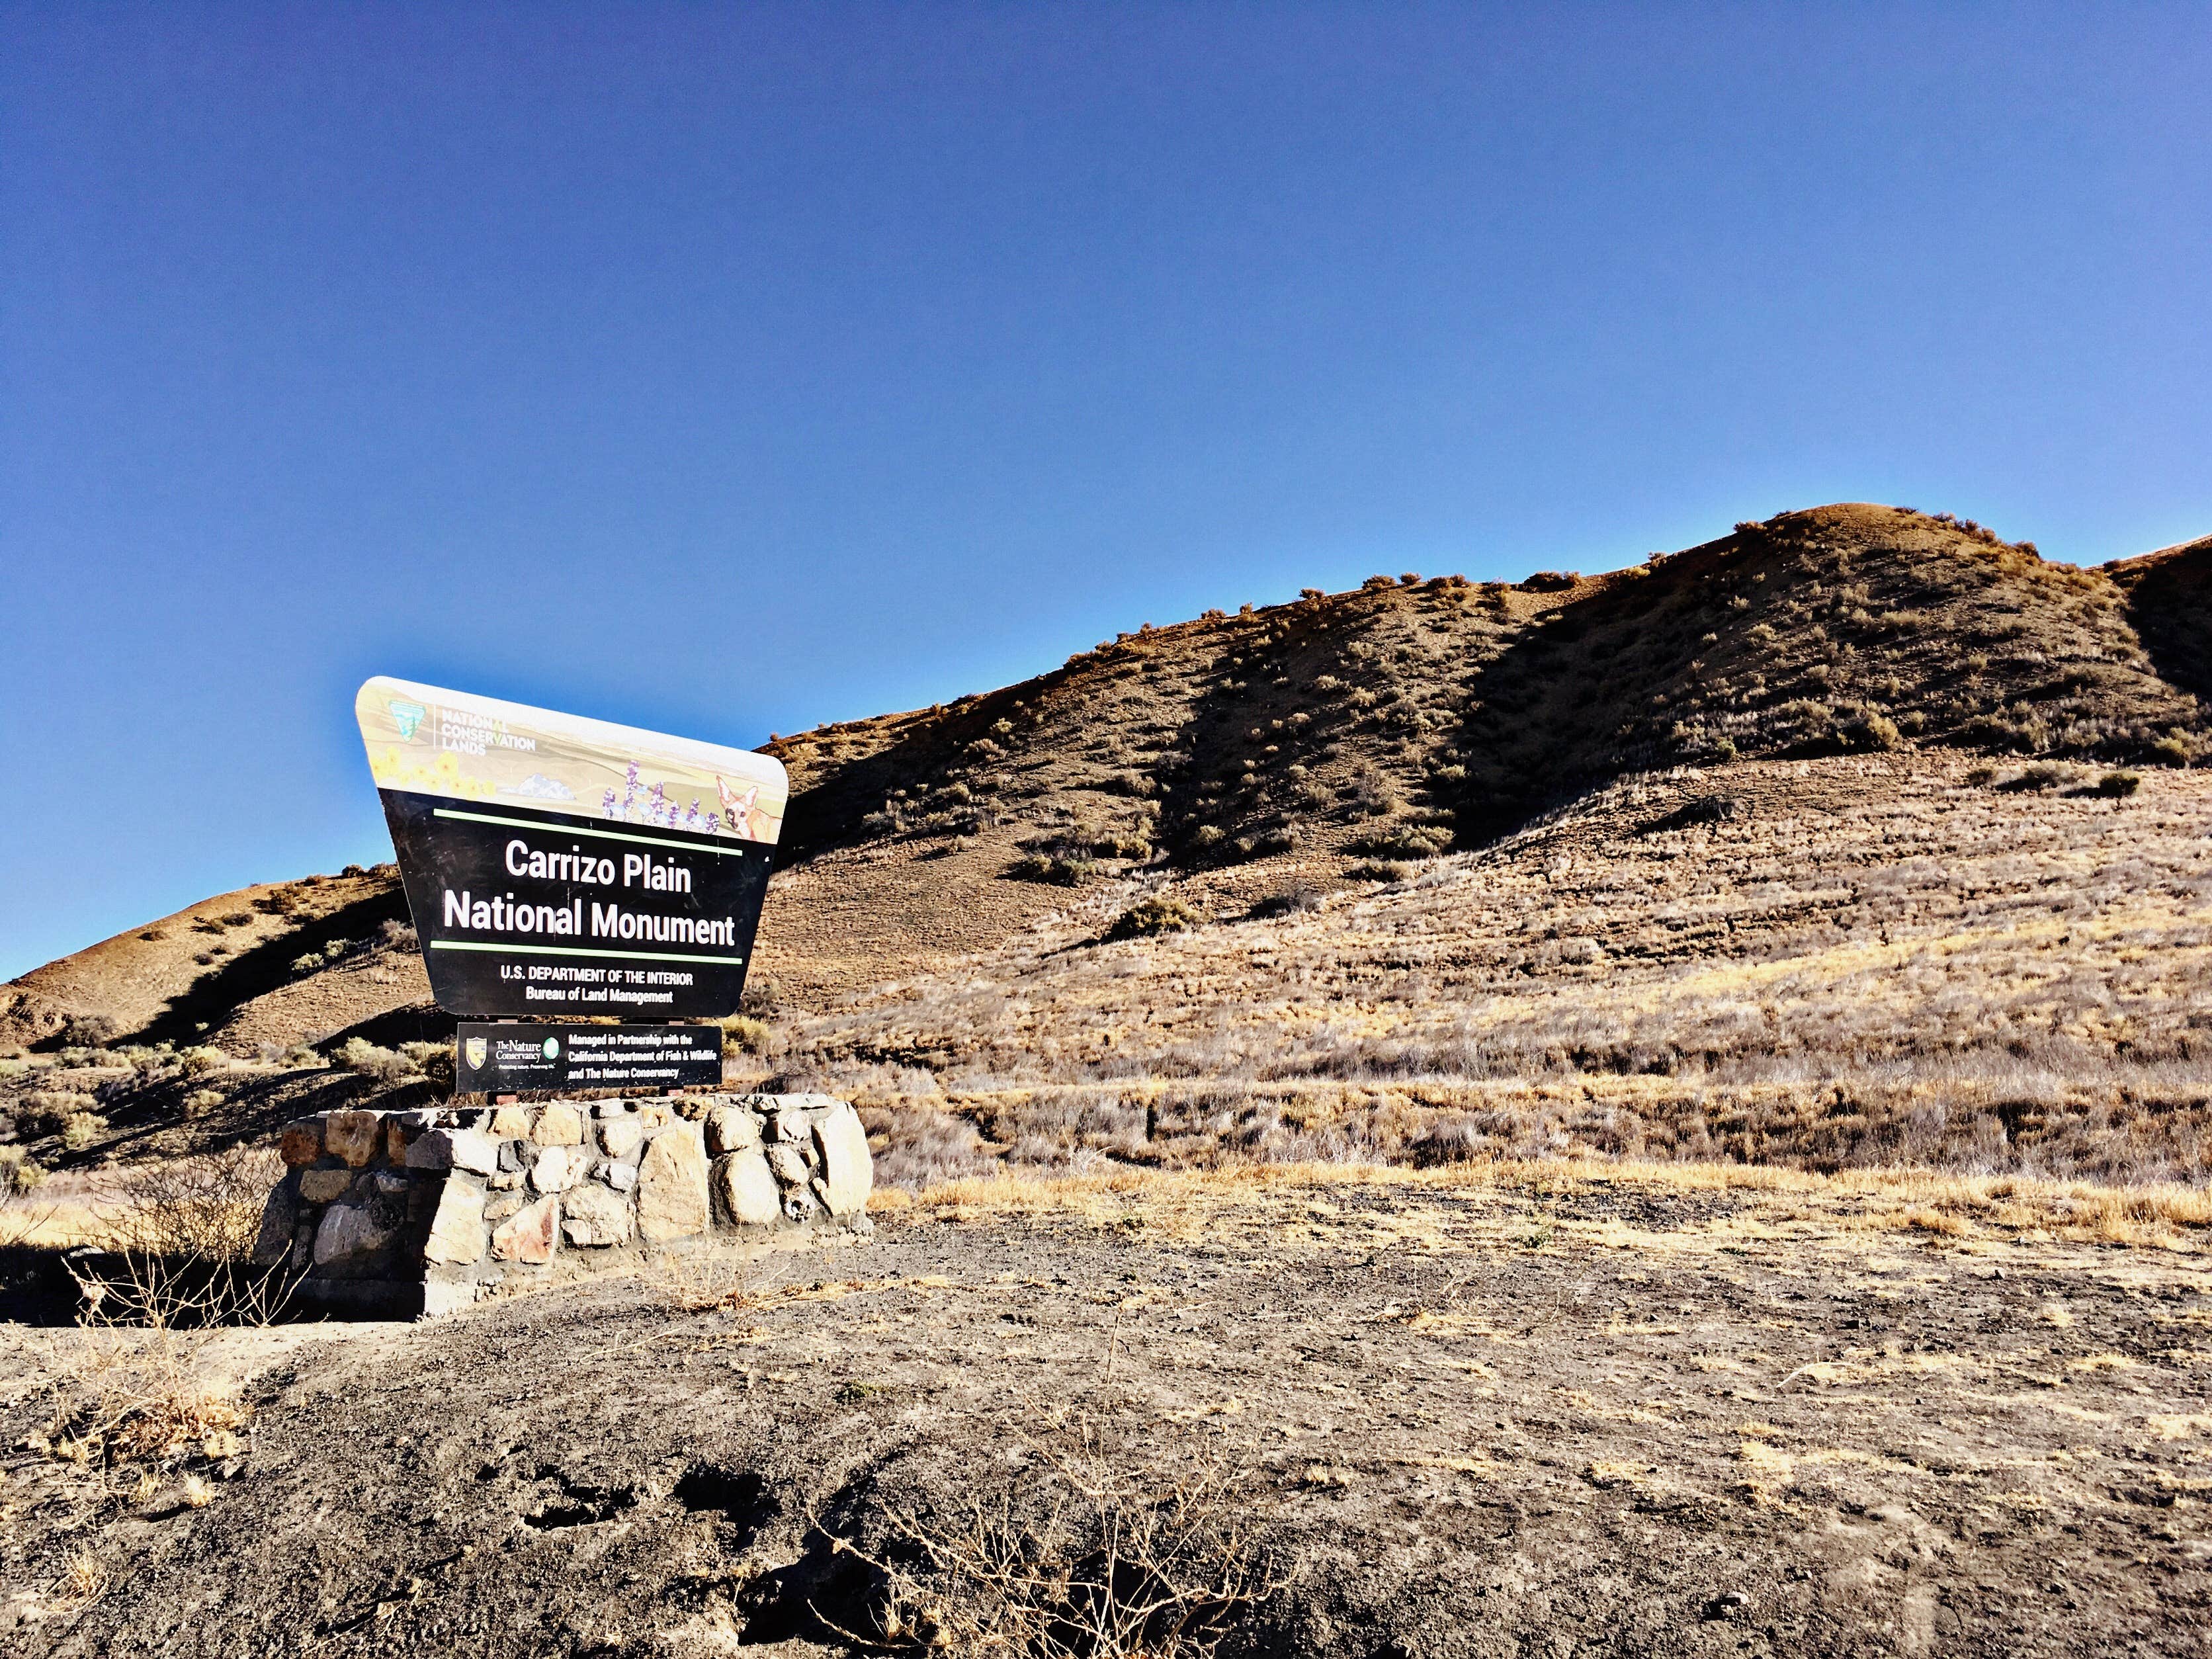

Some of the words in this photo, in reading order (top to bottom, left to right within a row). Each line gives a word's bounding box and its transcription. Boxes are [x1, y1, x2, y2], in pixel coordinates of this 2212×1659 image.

[442, 709, 509, 732] NATIONAL
[441, 723, 536, 751] CONSERVATION
[443, 738, 486, 756] LANDS
[505, 839, 615, 886] Carrizo
[624, 853, 691, 893] Plain
[444, 889, 581, 935] National
[592, 902, 735, 946] Monument
[501, 965, 525, 980] U.S.
[529, 966, 607, 982] DEPARTMENT
[608, 969, 622, 983] OF
[624, 970, 645, 984] THE
[647, 972, 693, 986] INTERIOR
[526, 986, 566, 1000] Bureau
[568, 987, 579, 1001] of
[581, 988, 607, 1001] Land
[610, 989, 673, 1005] Management
[497, 1041, 509, 1050] The
[509, 1040, 542, 1052] Nature
[568, 1034, 607, 1046] Managed
[608, 1034, 616, 1044] in
[618, 1034, 662, 1046] Partnership
[663, 1035, 679, 1044] with
[680, 1035, 693, 1044] the
[496, 1050, 541, 1063] Conservancy
[568, 1051, 608, 1062] California
[609, 1051, 655, 1063] Department
[656, 1050, 665, 1061] of
[665, 1050, 681, 1060] Fish
[682, 1051, 689, 1061] &
[690, 1050, 717, 1060] Wildlife
[568, 1068, 583, 1079] and
[585, 1068, 601, 1079] The
[603, 1068, 629, 1079] Nature
[630, 1068, 679, 1079] Conservancy
